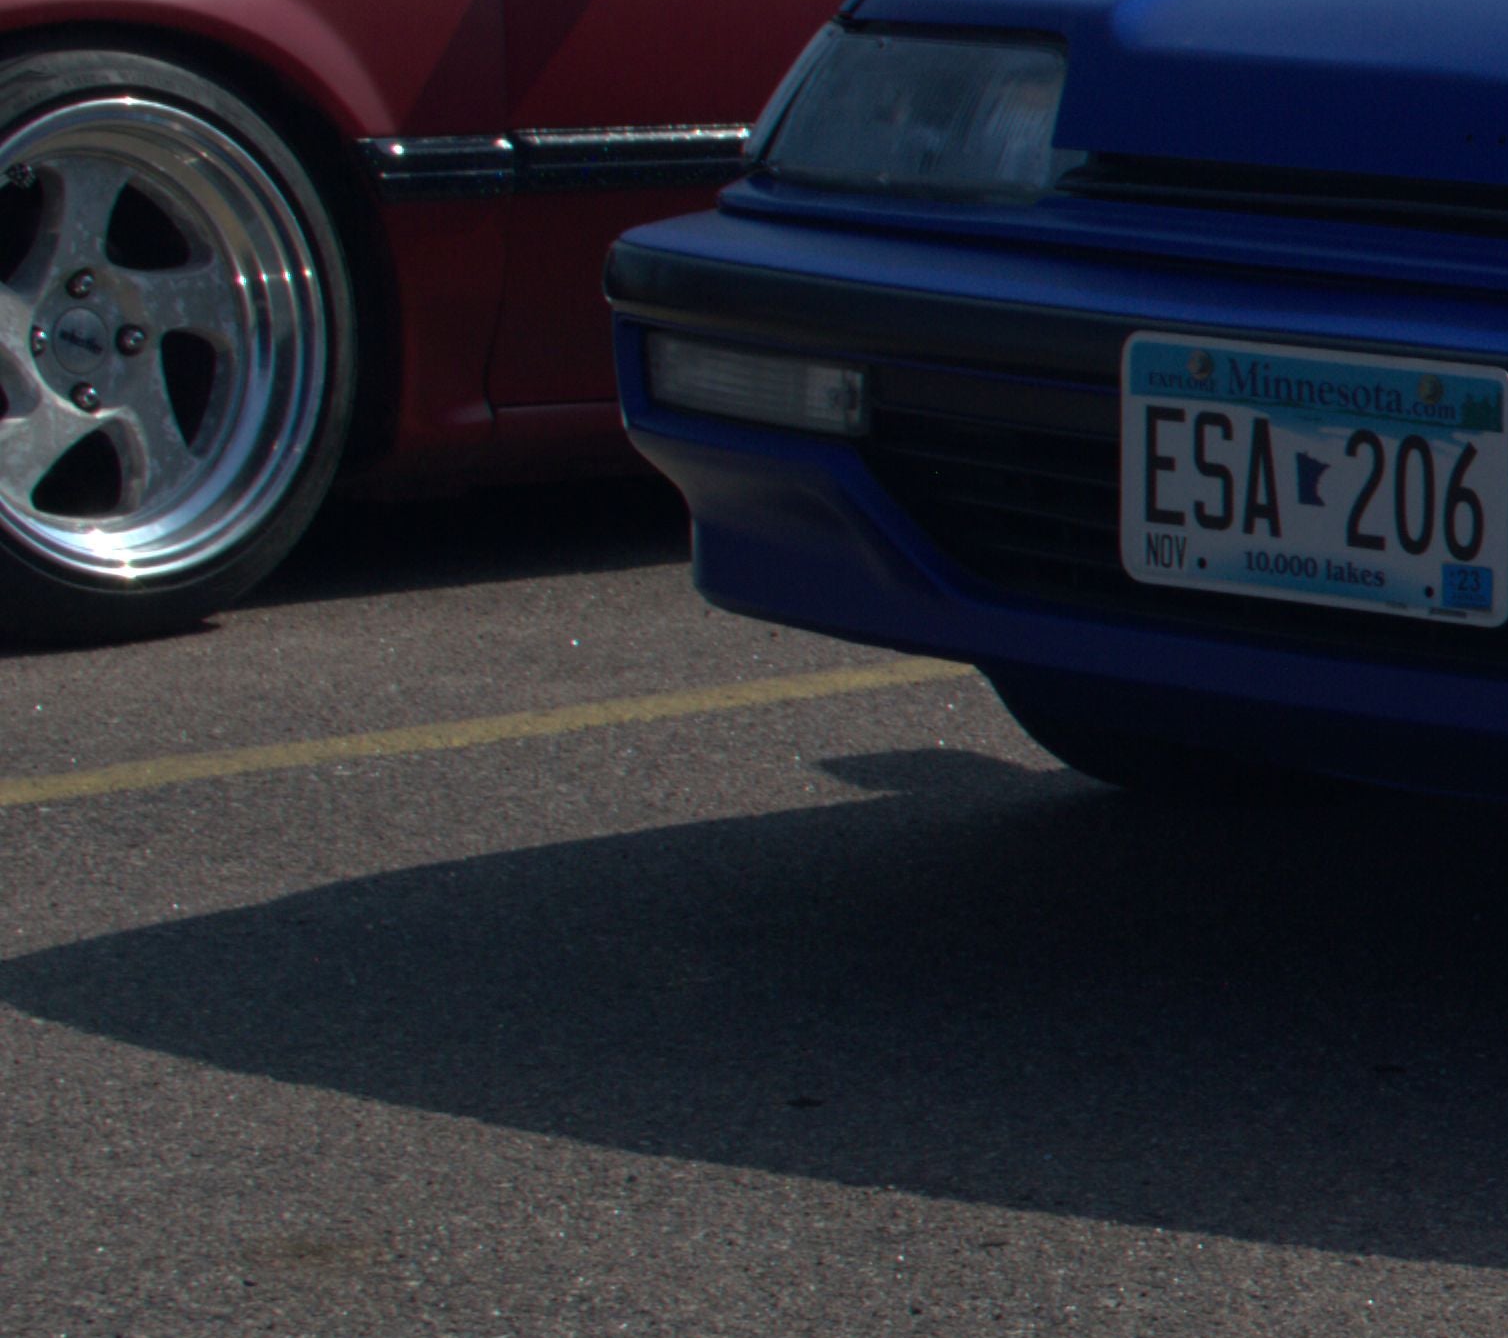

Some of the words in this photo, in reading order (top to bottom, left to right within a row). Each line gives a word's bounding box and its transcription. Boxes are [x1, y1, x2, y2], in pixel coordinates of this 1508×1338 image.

[1144, 404, 1283, 539] ESA
[1345, 428, 1485, 563] 206
[1145, 531, 1188, 571] NOV
[1324, 556, 1386, 588] lakes
